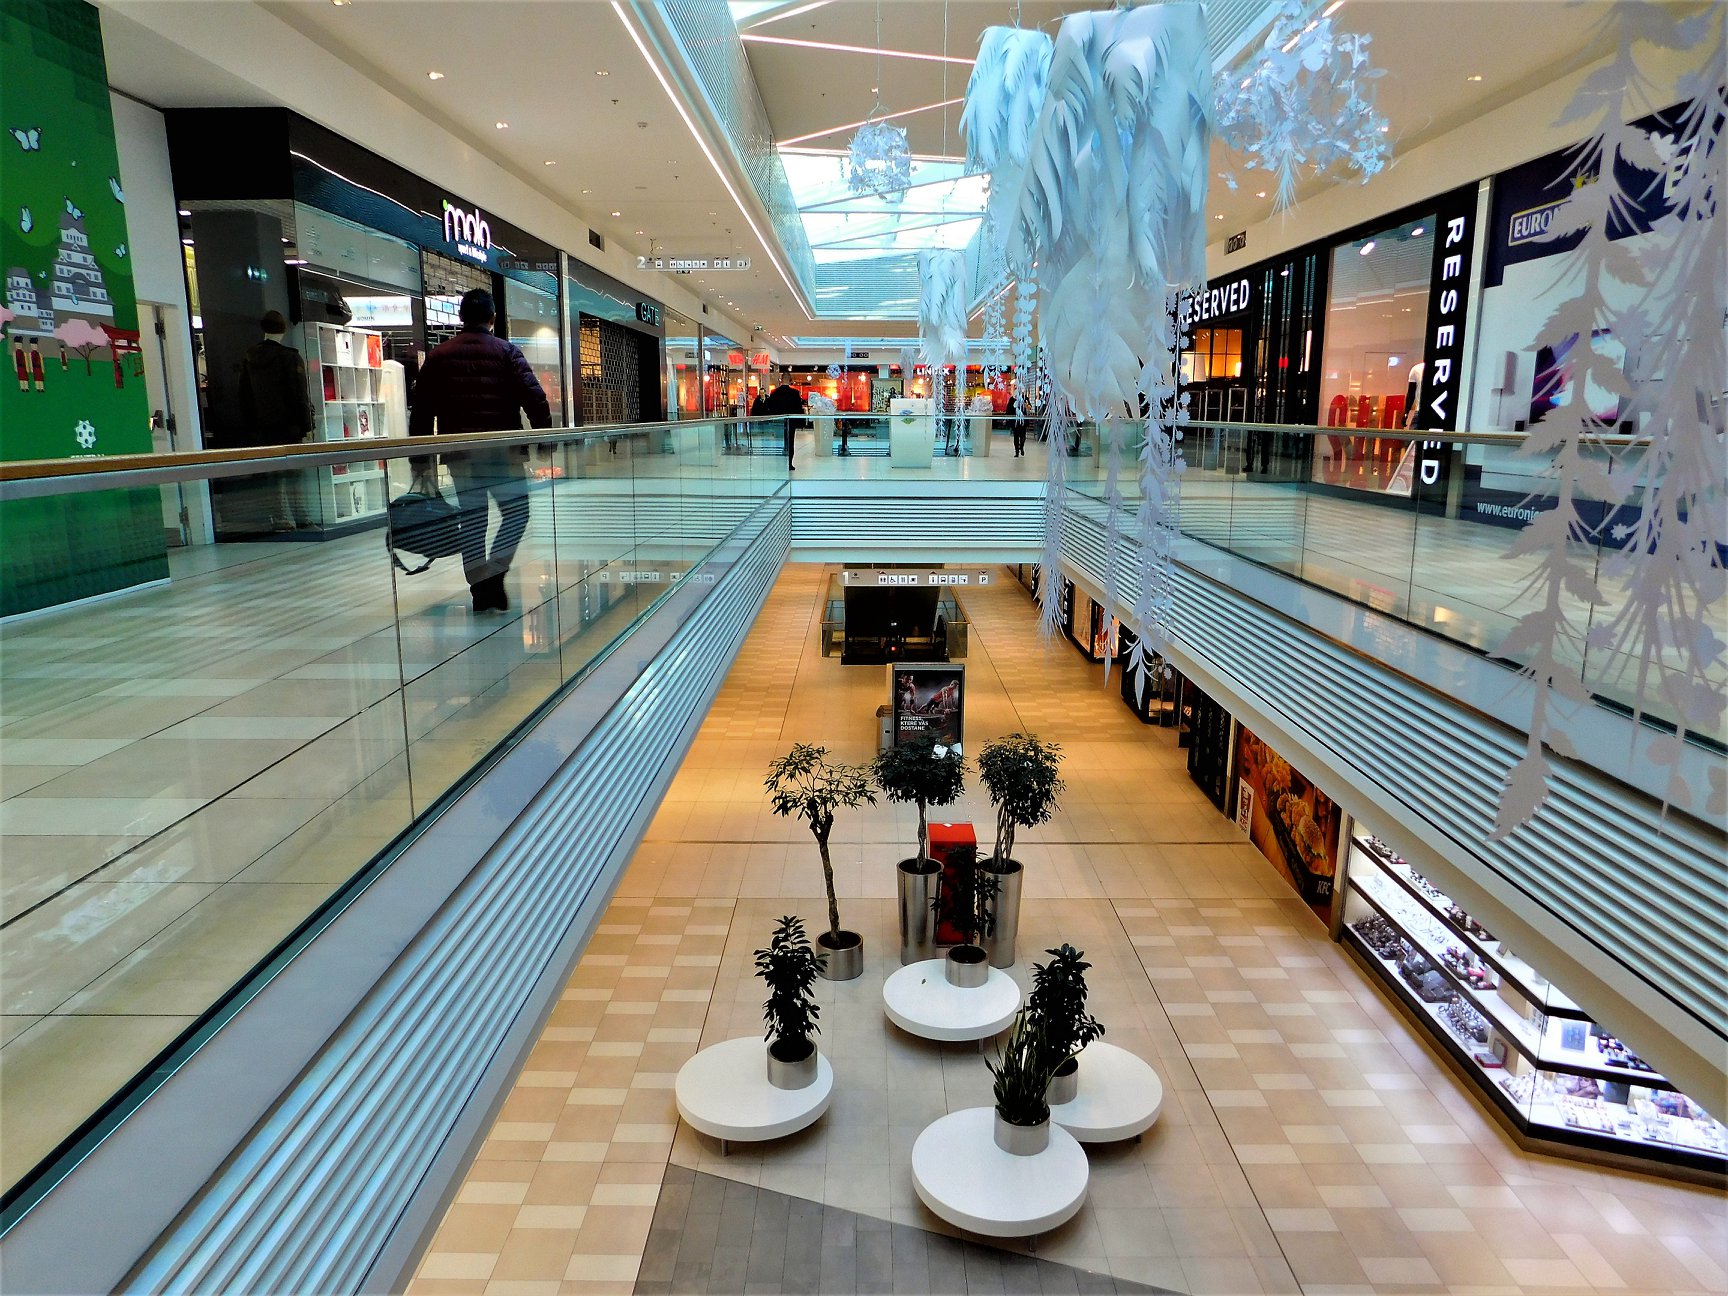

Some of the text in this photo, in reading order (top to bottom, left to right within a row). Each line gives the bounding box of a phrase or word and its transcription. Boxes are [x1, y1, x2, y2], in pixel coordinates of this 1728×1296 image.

[637, 256, 646, 269] 2
[1180, 279, 1249, 323] ESERVED
[641, 302, 660, 327] GATE
[843, 571, 849, 585] 1
[1317, 880, 1331, 895] KFC
